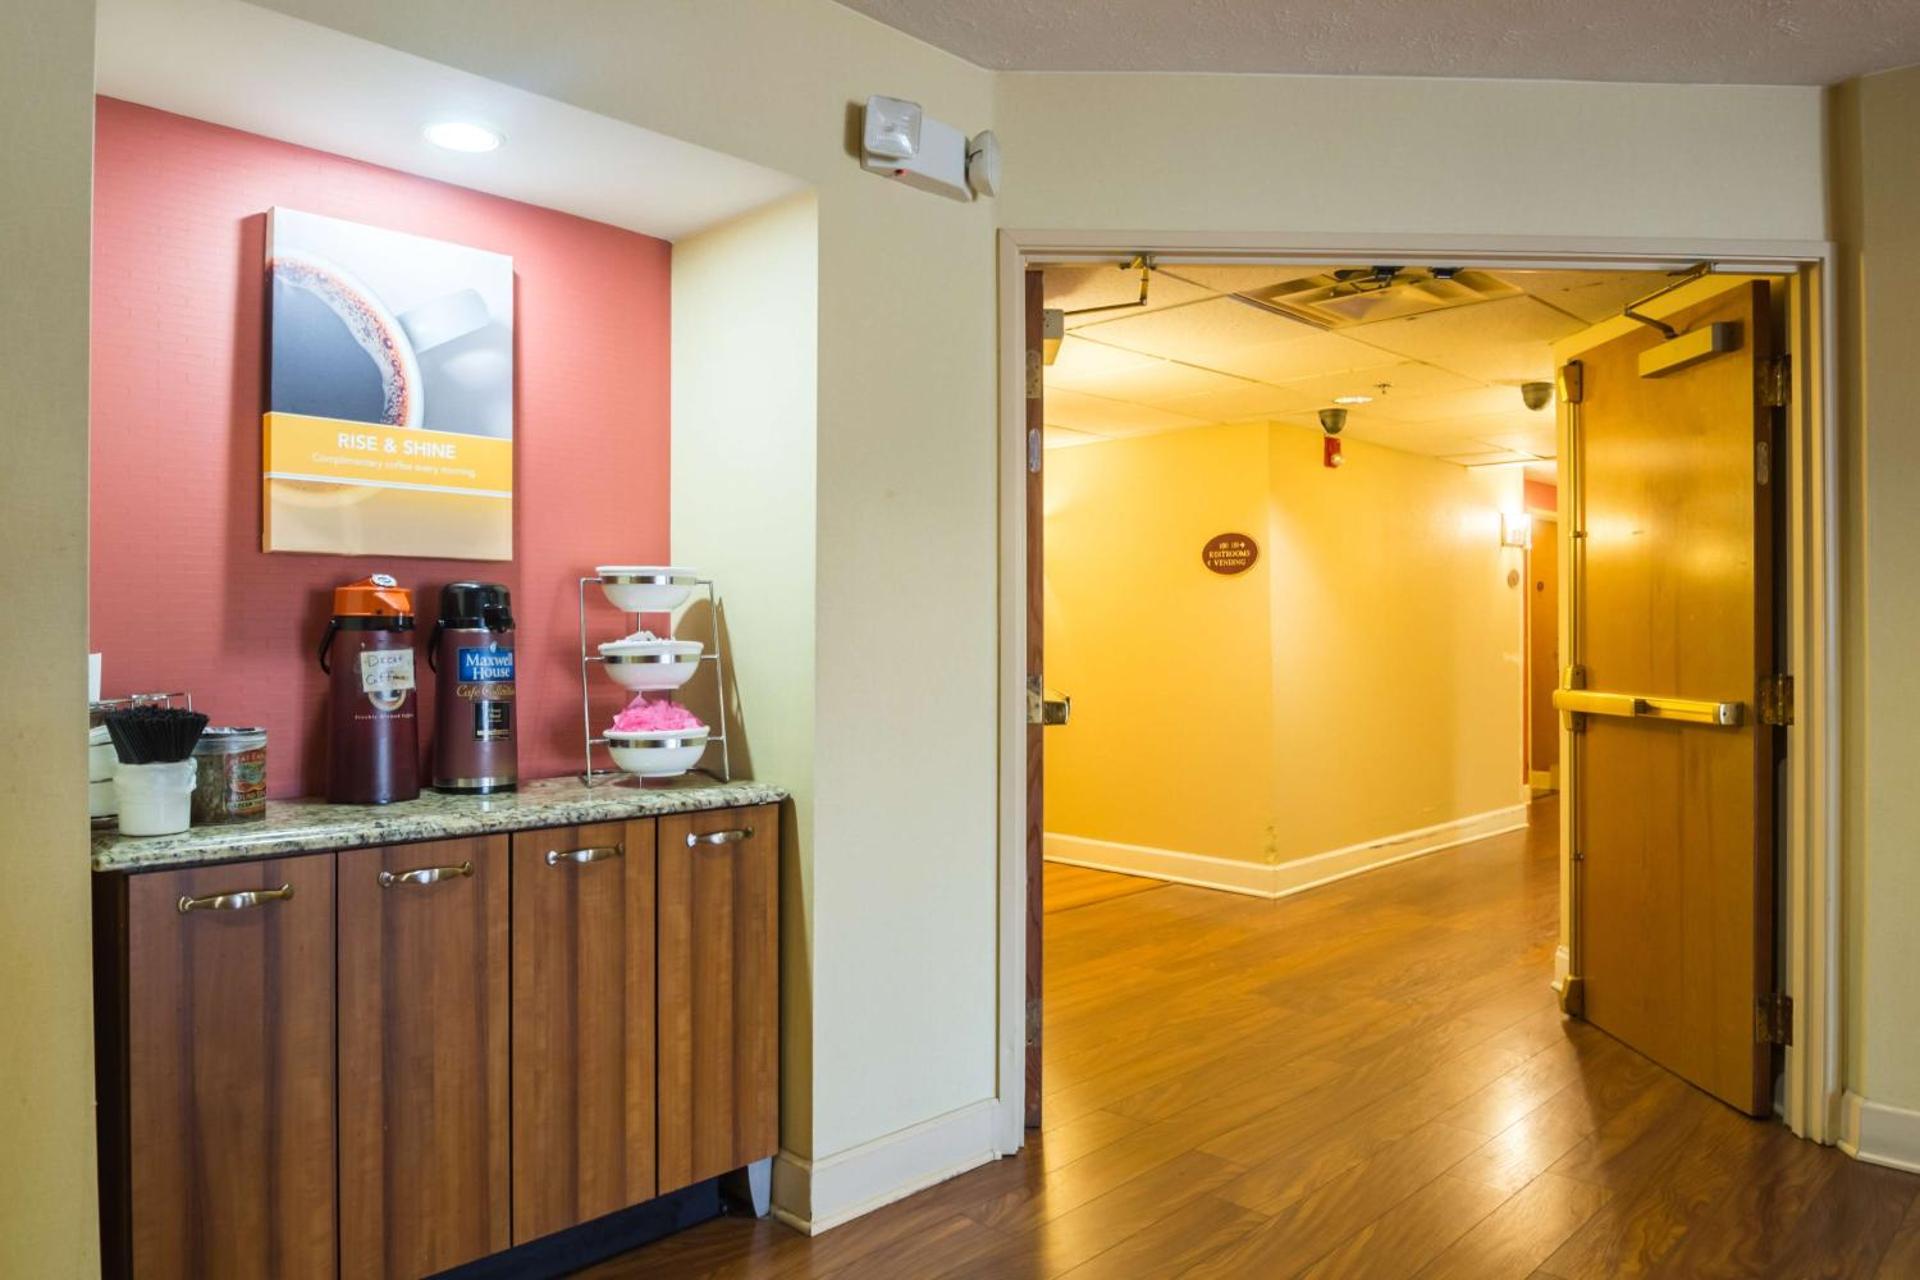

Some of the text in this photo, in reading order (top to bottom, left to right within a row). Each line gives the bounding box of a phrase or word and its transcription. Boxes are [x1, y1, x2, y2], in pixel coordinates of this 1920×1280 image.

[338, 433, 456, 459] RISE & SHINE
[311, 451, 382, 469] Complimentary
[384, 459, 413, 471] coffee
[440, 467, 476, 480] morning
[1214, 558, 1246, 567] VENDING
[466, 653, 513, 667] Maxwell
[473, 667, 511, 681] House
